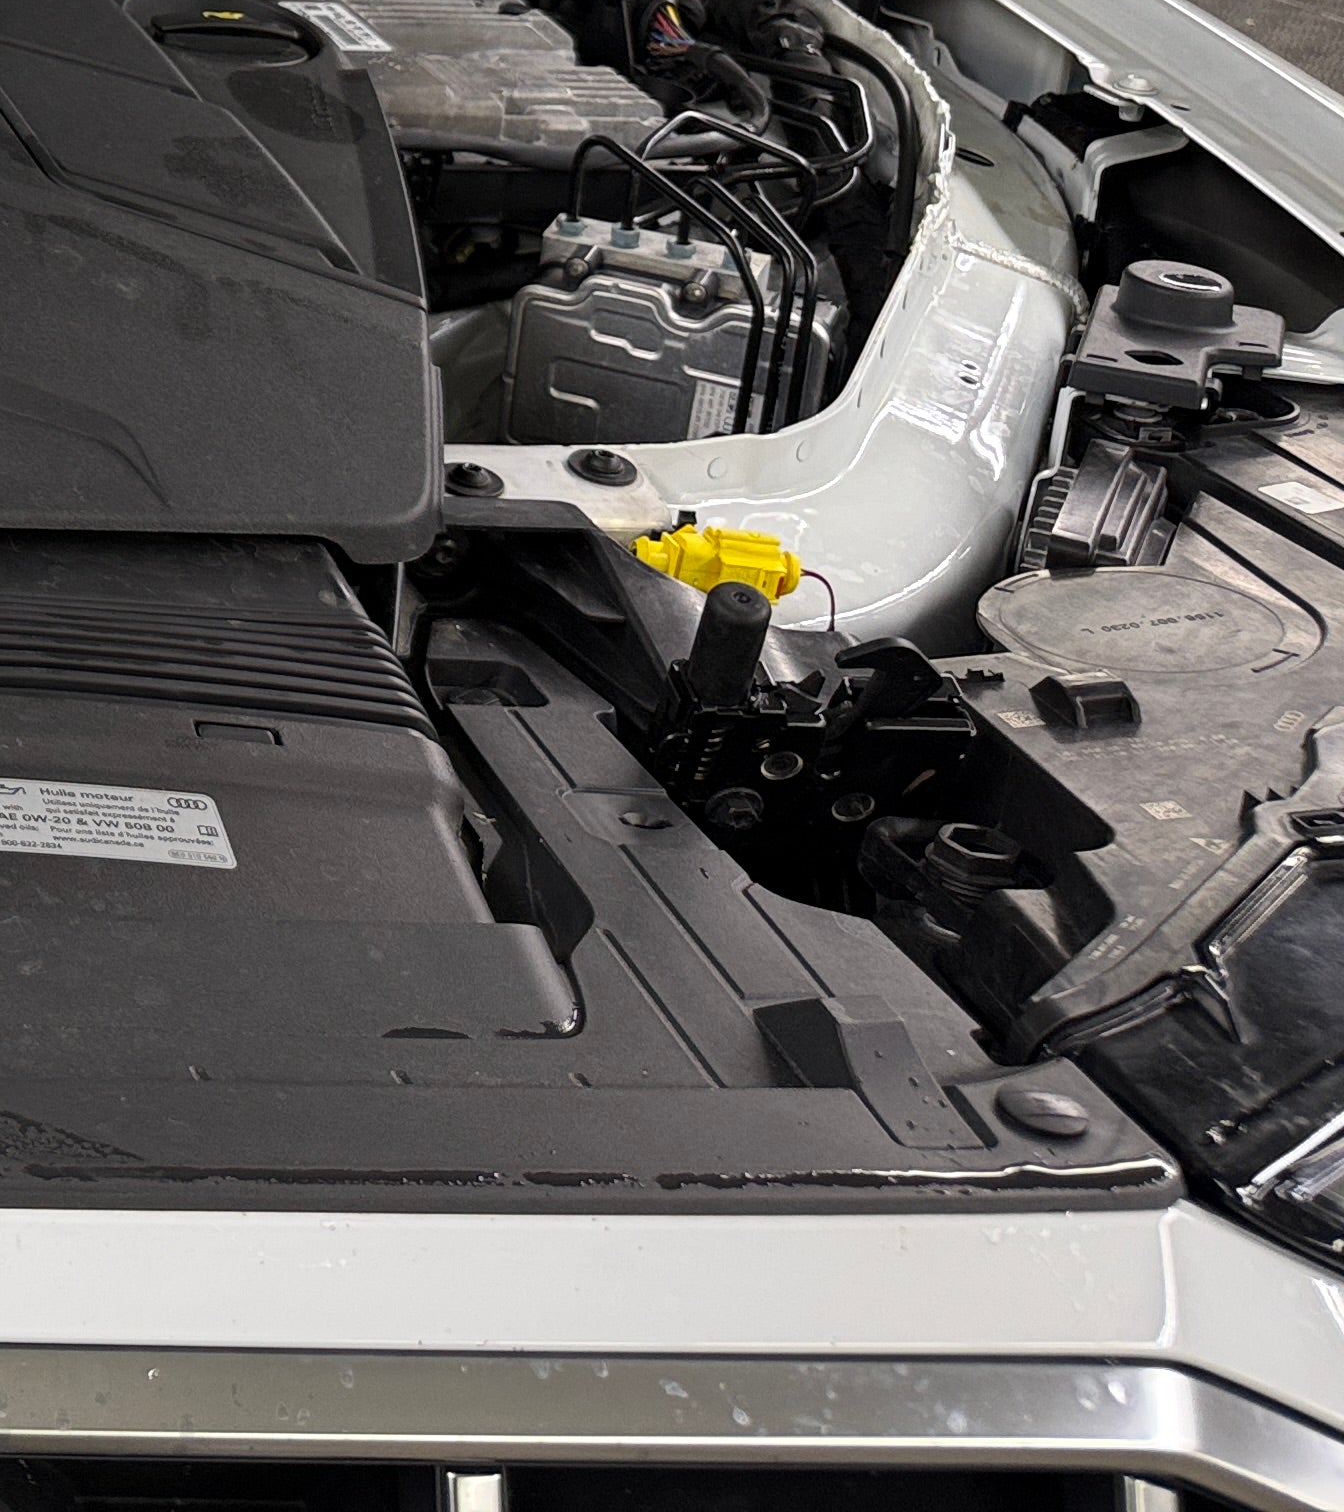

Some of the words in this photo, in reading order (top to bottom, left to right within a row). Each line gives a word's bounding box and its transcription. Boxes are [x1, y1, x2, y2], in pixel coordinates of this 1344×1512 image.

[40, 788, 76, 797] Huile
[80, 792, 133, 801] moteur
[63, 808, 99, 816] satisfait
[79, 802, 135, 811] uniquement
[22, 814, 71, 824] 0W-20
[92, 819, 119, 828] VW
[156, 825, 174, 833] 00
